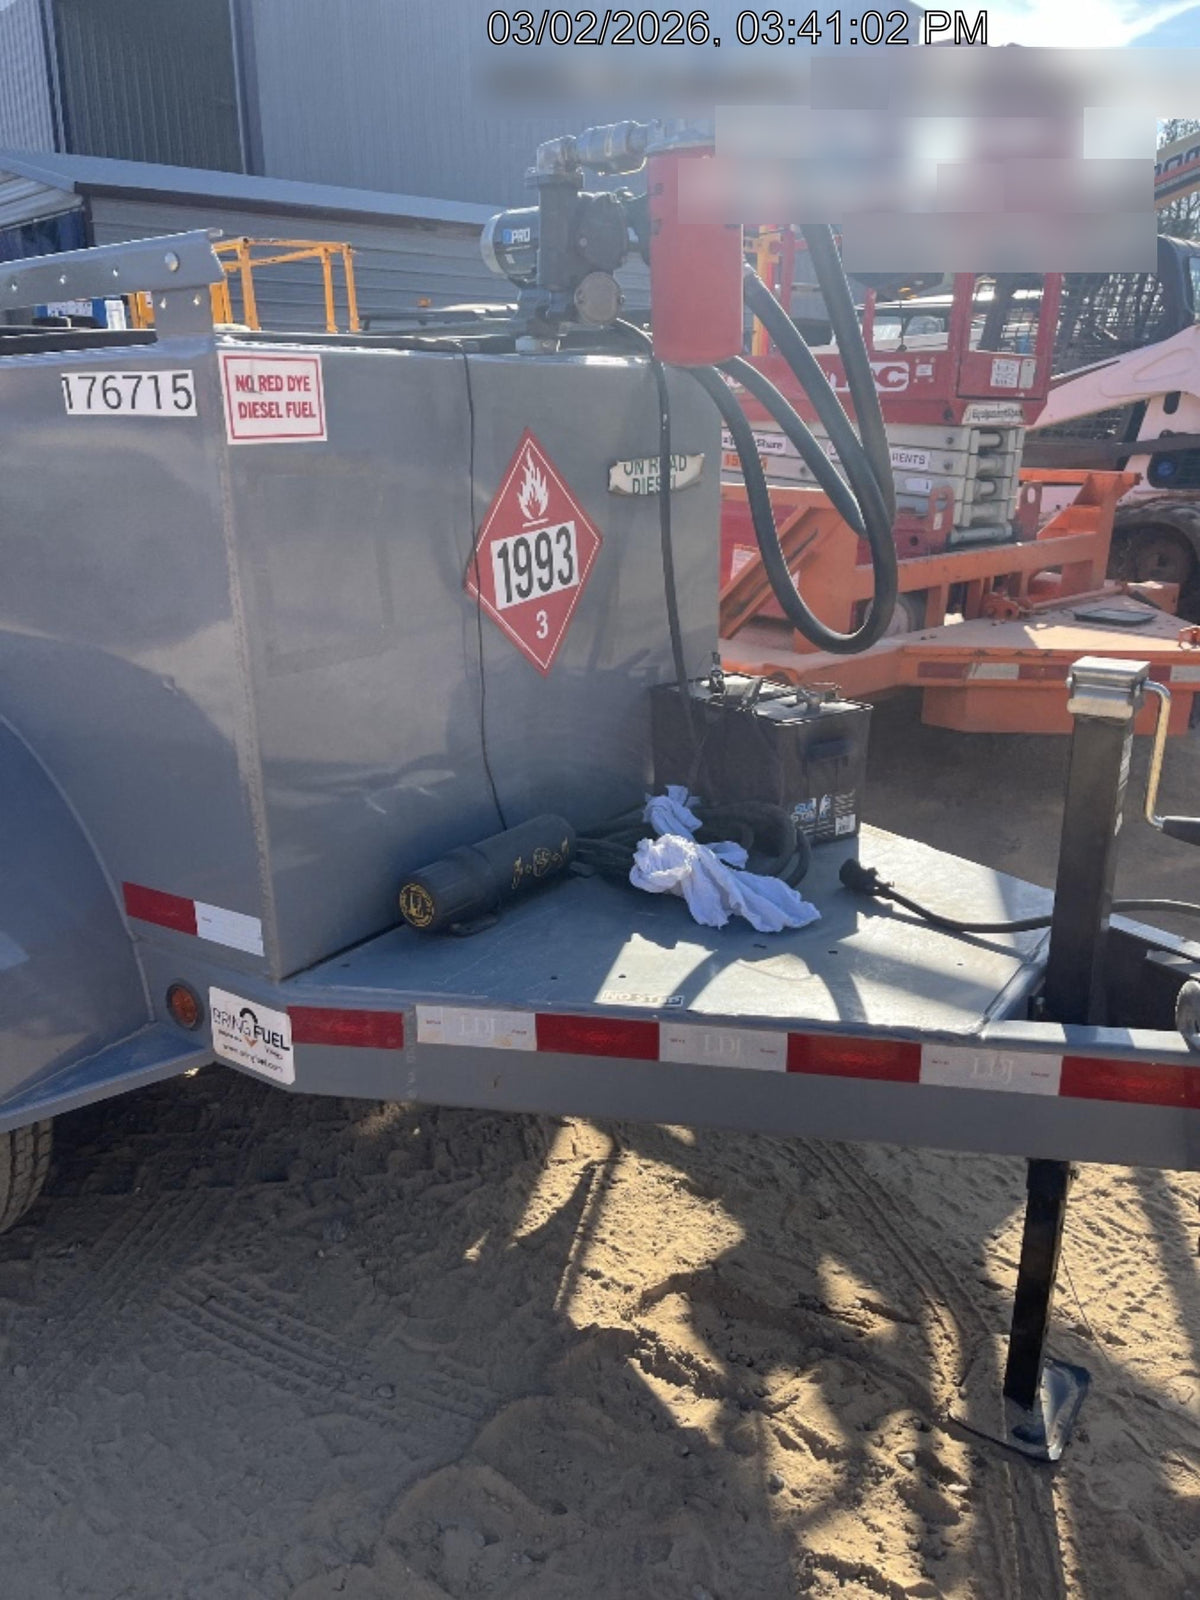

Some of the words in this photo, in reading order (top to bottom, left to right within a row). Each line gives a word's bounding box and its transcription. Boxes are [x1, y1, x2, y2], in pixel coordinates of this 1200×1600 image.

[62, 373, 193, 411] 176715
[235, 375, 256, 393] NO
[259, 375, 283, 392] RED
[287, 375, 312, 392] DYE
[238, 402, 284, 420] DIESEL
[286, 402, 317, 419] FUEL
[497, 526, 574, 603] 1993
[536, 609, 549, 639] 3
[253, 1025, 290, 1051] FUEL
